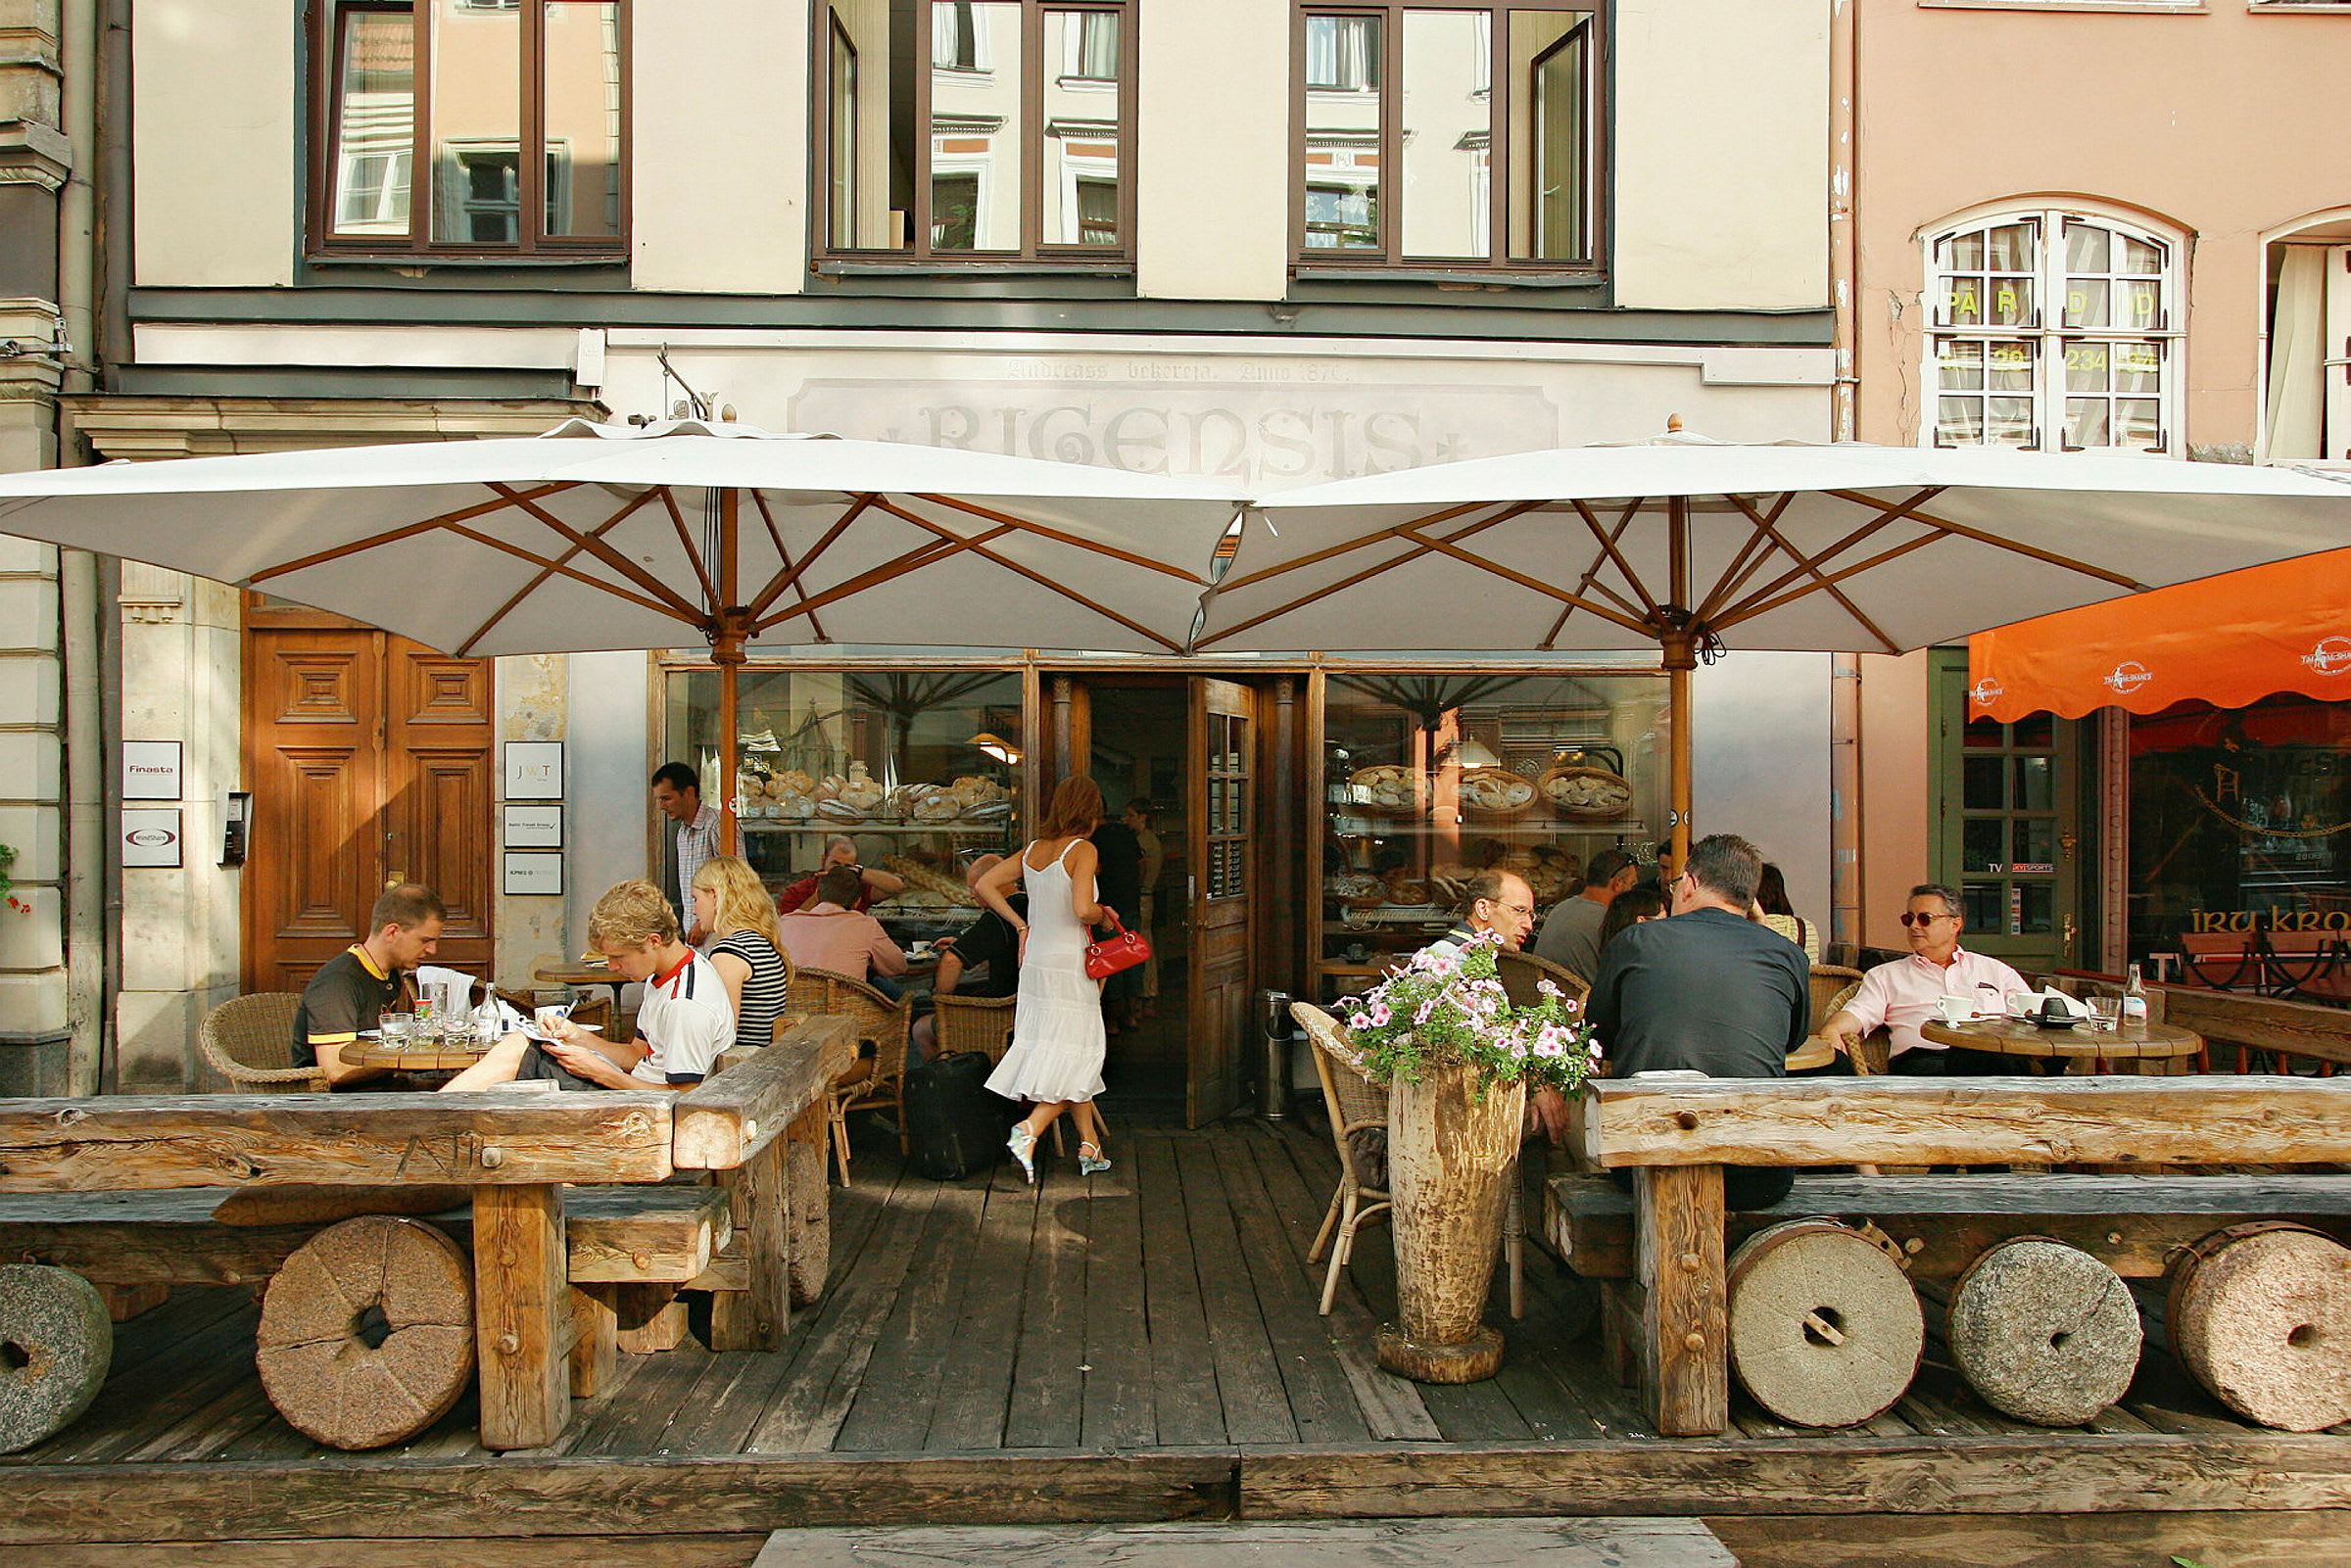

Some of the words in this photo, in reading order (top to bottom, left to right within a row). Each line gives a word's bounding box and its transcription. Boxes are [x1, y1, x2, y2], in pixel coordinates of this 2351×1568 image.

[2066, 349, 2107, 372] 234
[129, 765, 173, 774] Finasta
[517, 765, 551, 780] JWT
[1989, 863, 2003, 873] TV
